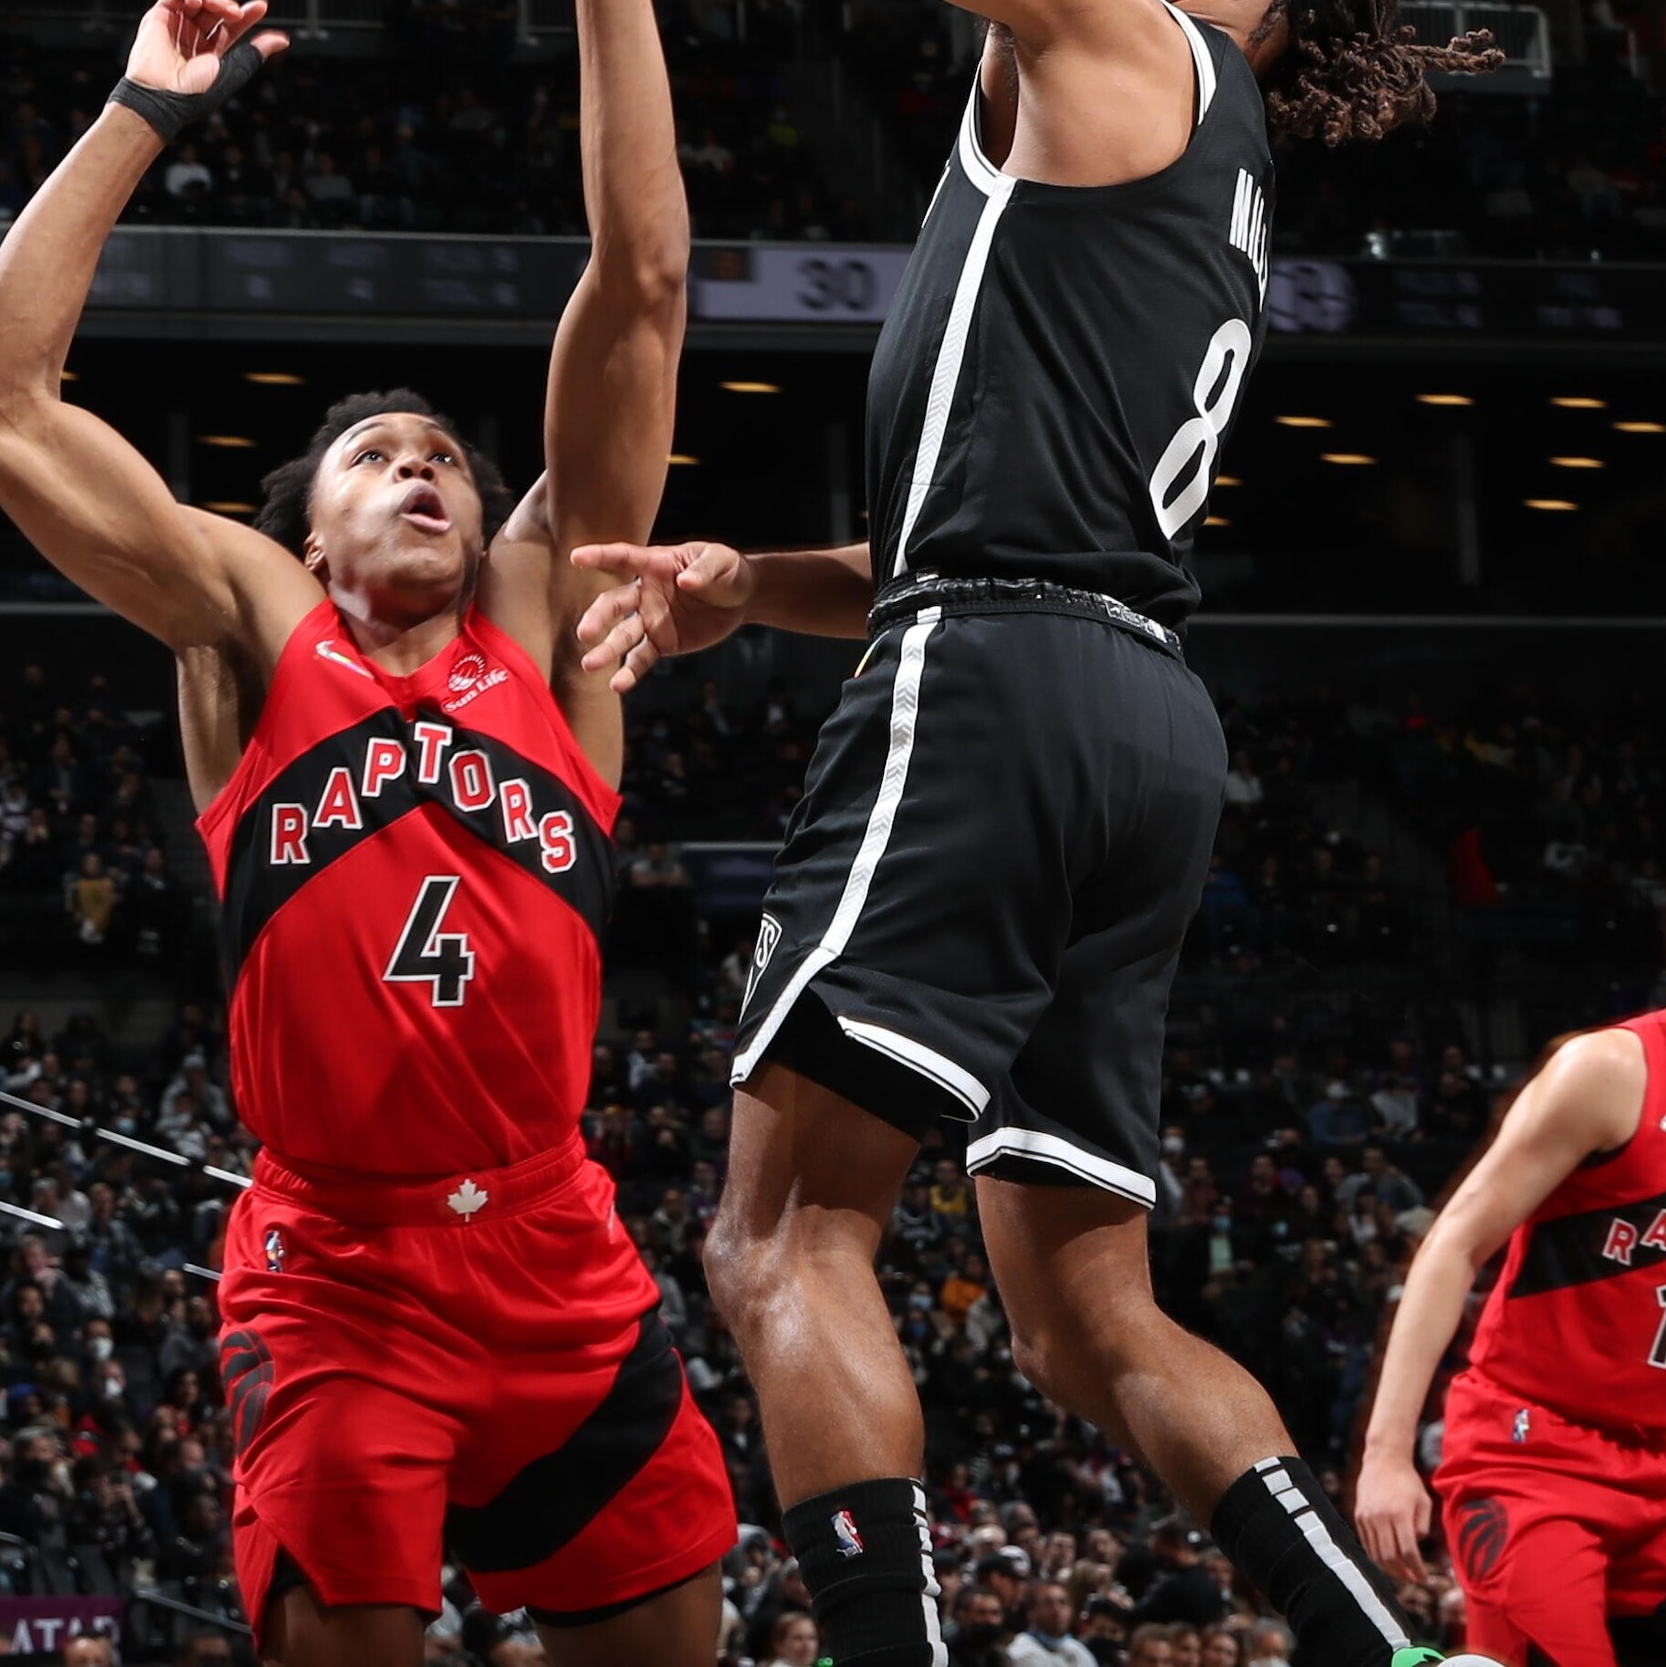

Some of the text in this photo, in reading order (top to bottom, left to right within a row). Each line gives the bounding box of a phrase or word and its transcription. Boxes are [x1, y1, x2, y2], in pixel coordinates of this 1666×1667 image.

[1149, 318, 1251, 541] 8
[269, 721, 577, 874] RAPTORS
[382, 875, 475, 1007] 4
